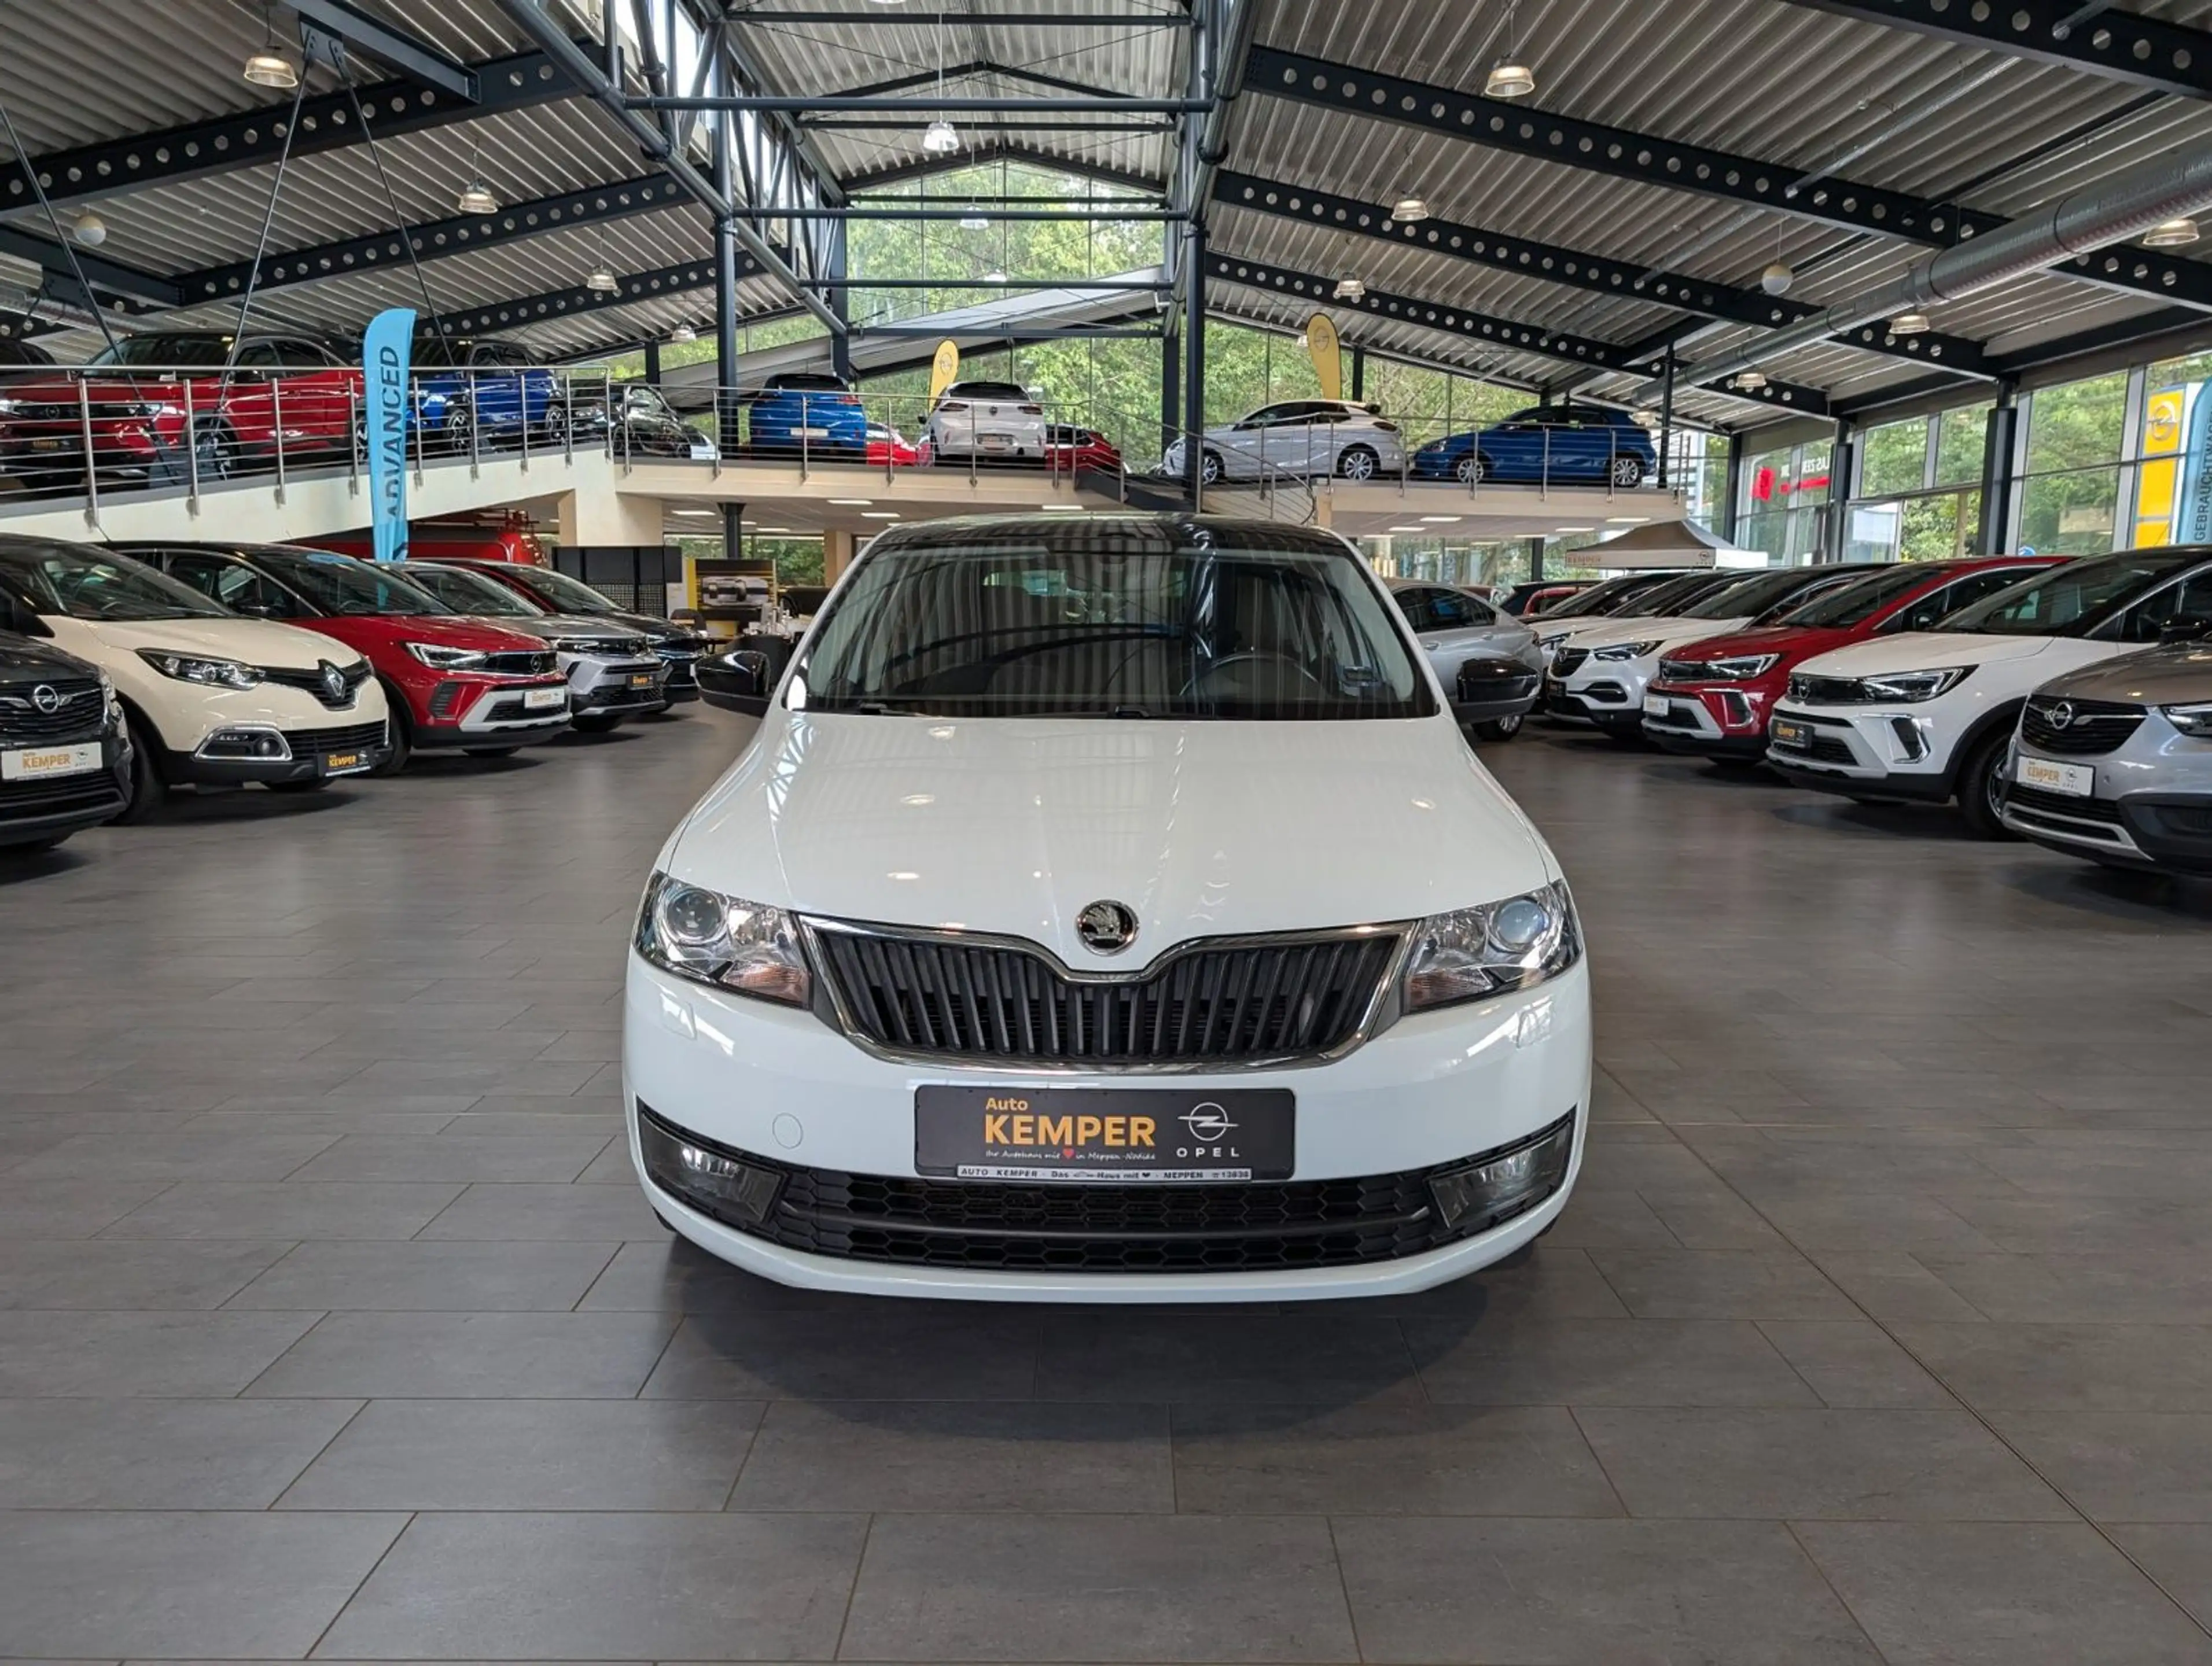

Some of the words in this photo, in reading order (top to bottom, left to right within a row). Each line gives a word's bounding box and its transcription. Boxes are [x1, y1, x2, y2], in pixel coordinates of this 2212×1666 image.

[379, 345, 404, 518] ADVANCED
[2193, 406, 2212, 541] GEBRAUCHTWAG
[22, 753, 71, 768] KEMPER
[985, 1097, 1028, 1111] Auto
[985, 1114, 1156, 1147] KEMPER
[1044, 1151, 1060, 1159] mit
[1176, 1147, 1240, 1158] OPEL
[996, 1169, 1037, 1178] KEMPER
